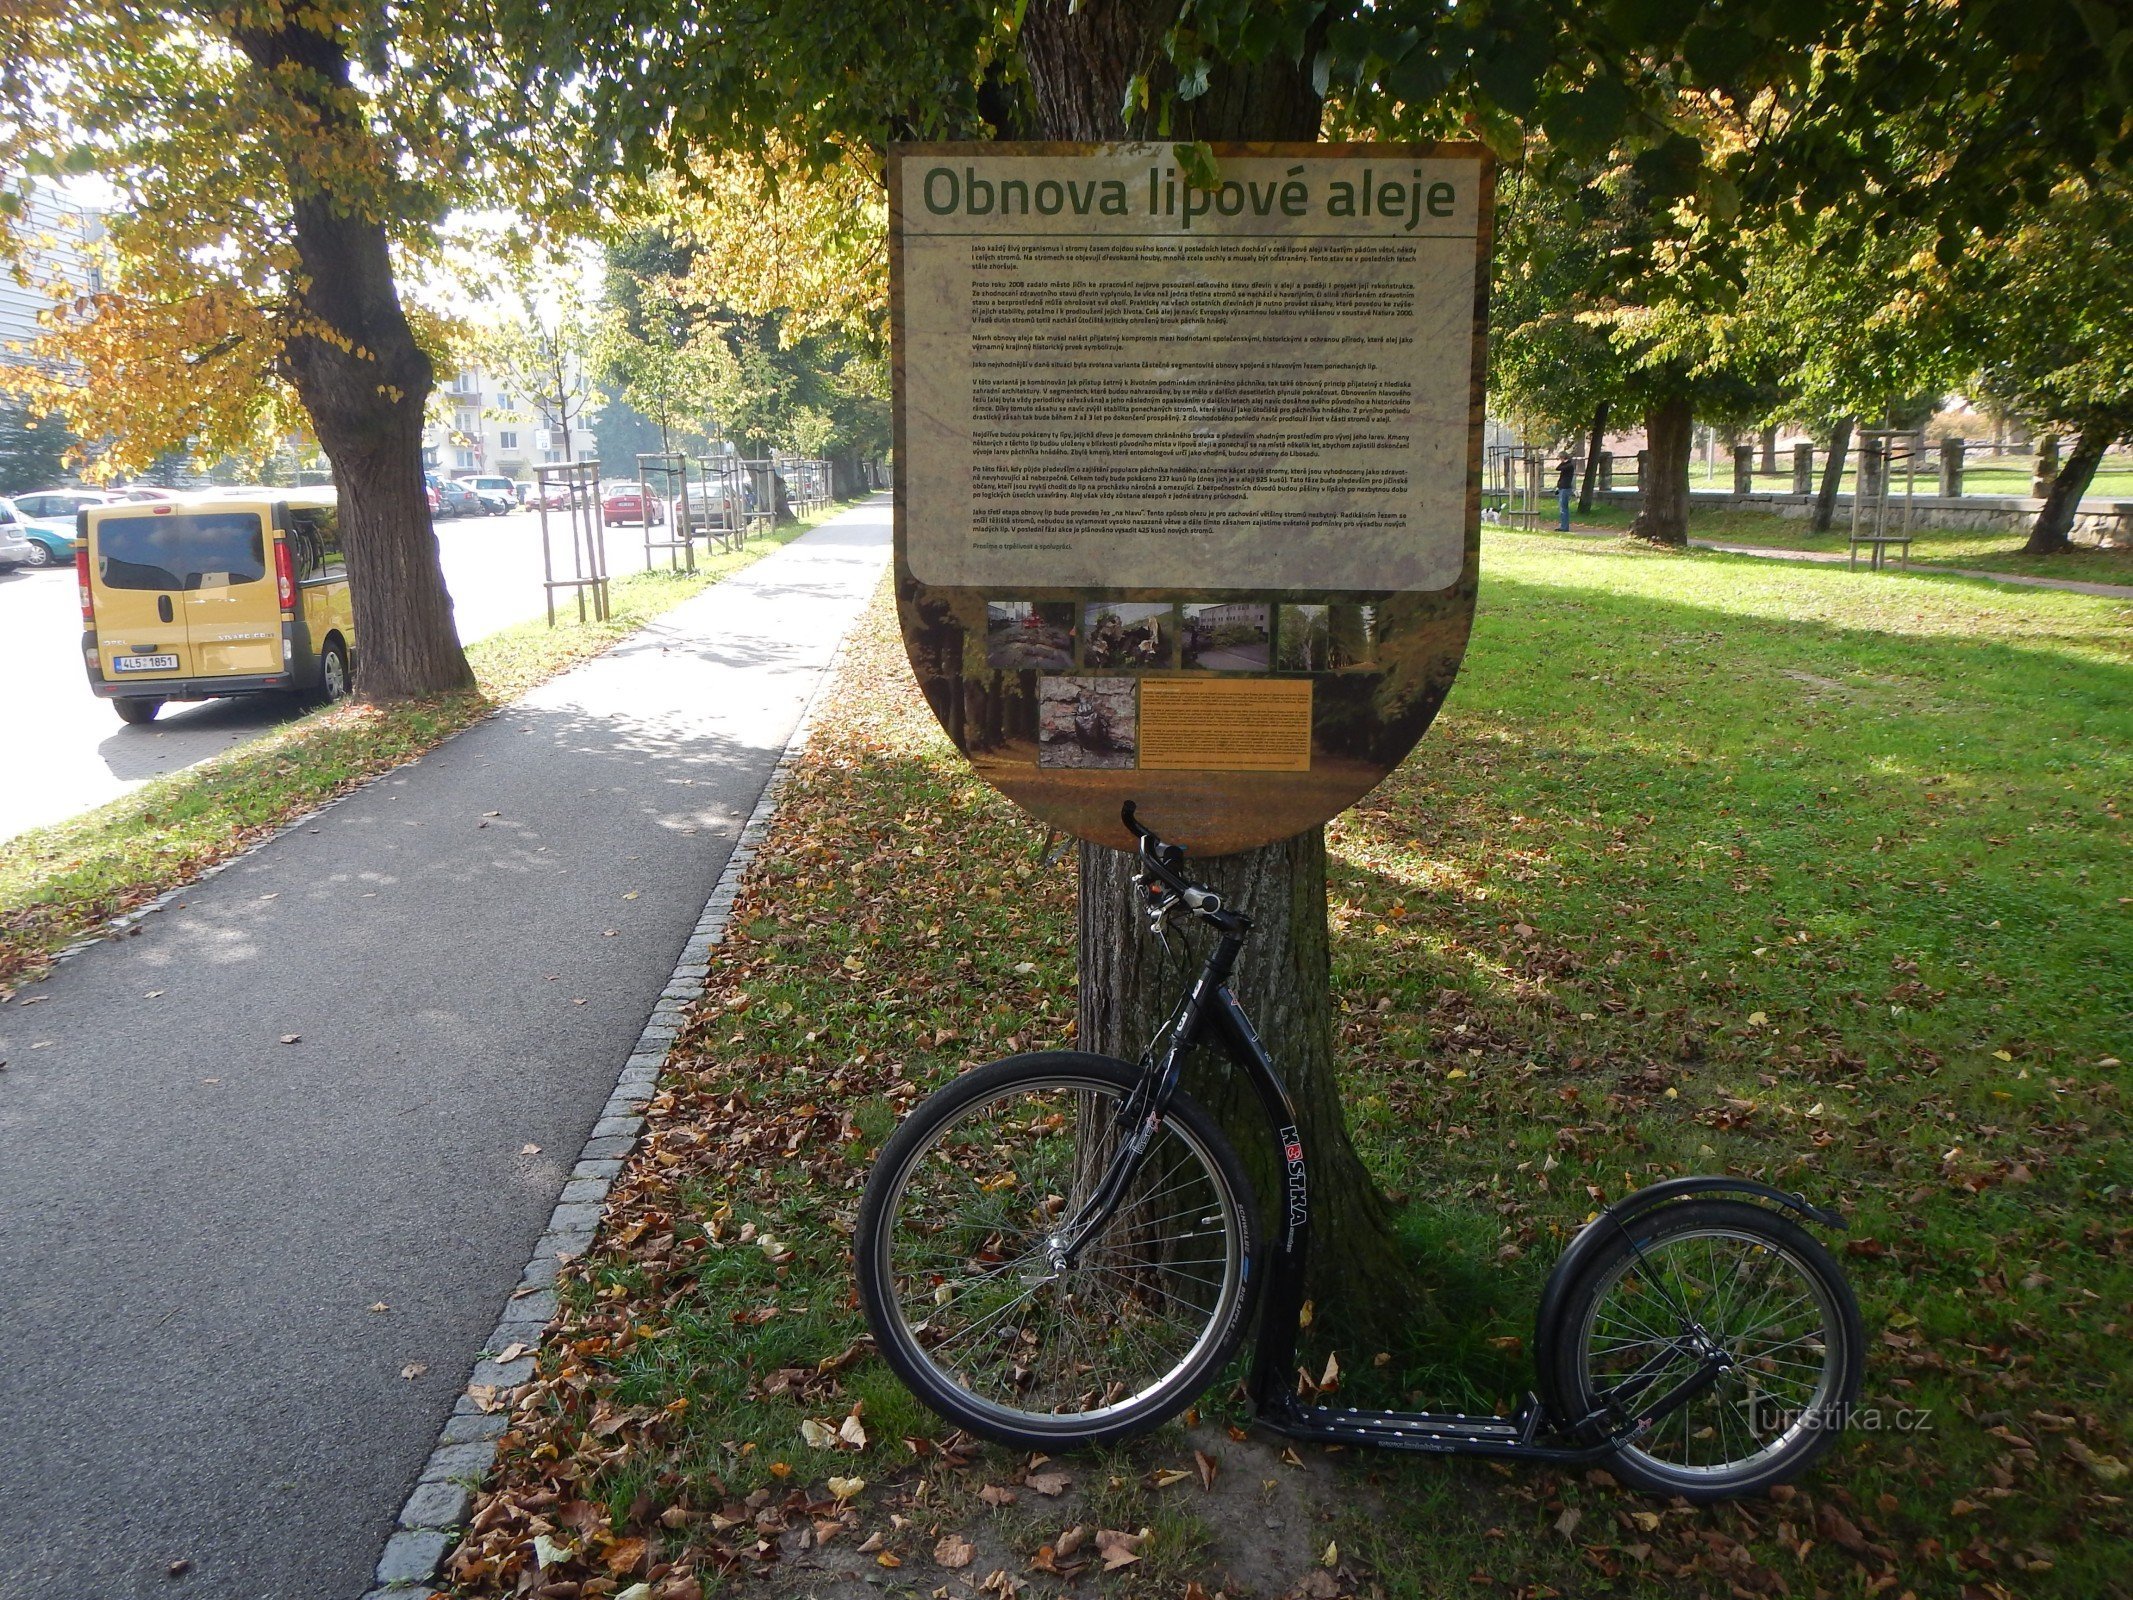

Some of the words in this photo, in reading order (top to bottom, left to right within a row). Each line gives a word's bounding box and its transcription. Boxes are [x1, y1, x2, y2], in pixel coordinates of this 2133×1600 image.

[923, 166, 1128, 216] Obnova
[1150, 164, 1307, 229] lipové
[1327, 168, 1456, 232] aleje
[1022, 244, 1060, 253] organismus
[1065, 245, 1088, 254] stromy
[1309, 245, 1323, 254] aleji
[1205, 254, 1226, 263] uschly
[1233, 254, 1257, 263] musely
[1136, 281, 1160, 290] nejprve
[1334, 282, 1357, 291] projekt
[1170, 290, 1188, 299] jedna
[1130, 299, 1160, 308] Prakticky
[1354, 300, 1382, 309] povedou
[1104, 308, 1122, 316] jejich
[1161, 308, 1173, 317] alej
[1200, 308, 1229, 317] Evropsky
[993, 334, 1016, 342] obnovy
[1018, 334, 1033, 343] aleje
[1122, 334, 1158, 343] kompromis
[1065, 343, 1083, 352] prvek
[1074, 361, 1088, 370] byla
[1216, 362, 1239, 370] obnovy
[1324, 380, 1346, 388] princip
[1002, 396, 1016, 404] byla
[1033, 396, 1065, 405] periodicky
[1111, 396, 1125, 405] jeho
[1237, 406, 1252, 415] jako
[1384, 406, 1411, 415] pohledu
[1234, 414, 1260, 423] pohledu
[1353, 433, 1367, 442] jeho
[1388, 433, 1410, 442] Kmeny
[1322, 442, 1351, 450] abychom
[1188, 449, 1202, 458] jako
[1011, 465, 1022, 474] kdy
[1110, 466, 1139, 475] populace
[1308, 467, 1322, 476] jsou
[1366, 468, 1380, 477] jako
[1095, 474, 1109, 483] tedy
[1013, 482, 1027, 491] jsou
[1070, 492, 1083, 500] Alej
[1191, 492, 1212, 501] strany
[1002, 508, 1020, 517] etapa
[1021, 508, 1043, 517] obnovy
[1109, 518, 1131, 526] vysoko
[1115, 526, 1137, 535] vysadit
[123, 658, 141, 669] 4L5
[149, 656, 173, 668] 1851
